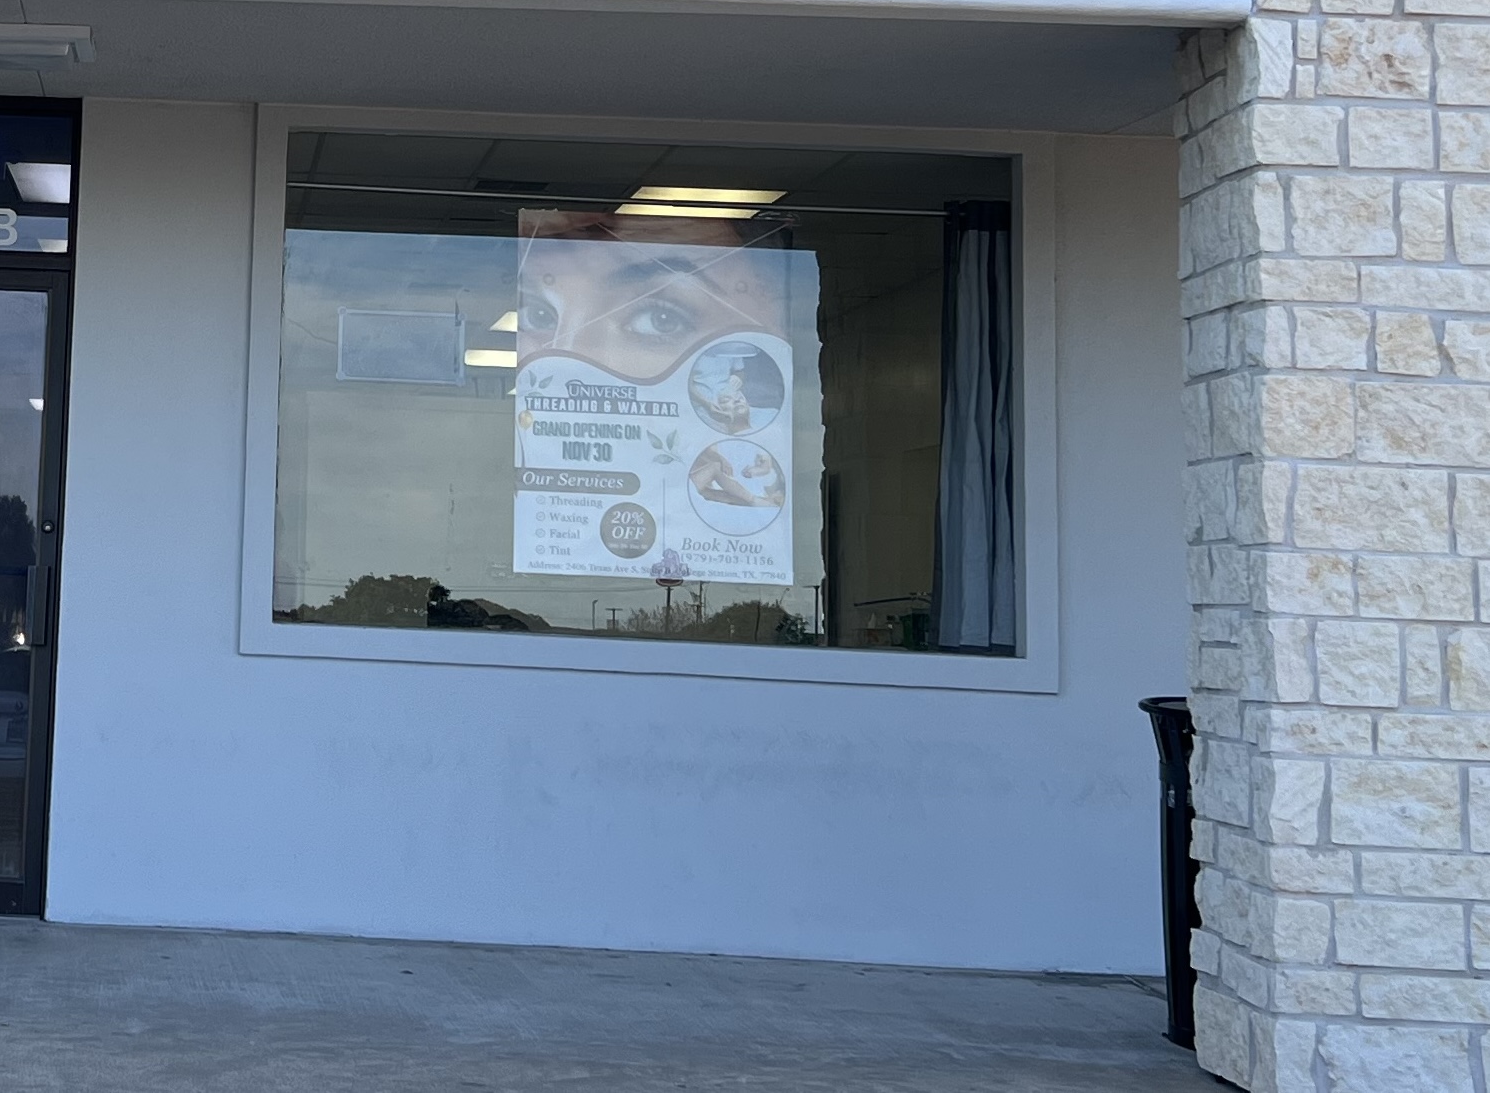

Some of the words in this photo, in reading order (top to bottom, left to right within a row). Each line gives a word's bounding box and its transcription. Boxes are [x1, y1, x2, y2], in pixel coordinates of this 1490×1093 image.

[568, 384, 636, 400] UNIVERSE
[526, 397, 598, 412] THREADING
[604, 401, 612, 413] &
[617, 401, 647, 415] WAX
[652, 403, 679, 417] BAR
[533, 420, 572, 437] GRAND
[573, 422, 624, 439] OPENING
[624, 424, 641, 440] ON
[562, 440, 592, 460] NOV
[593, 442, 613, 462] 30
[522, 471, 554, 486] Our
[557, 472, 624, 489] Services
[549, 495, 603, 508] Threading
[549, 511, 589, 524] Waxing
[611, 510, 645, 526] 20%
[549, 528, 580, 540] Facial
[611, 525, 646, 540] OFF
[549, 545, 572, 556] Tint
[681, 537, 721, 553] Book
[724, 539, 763, 555] Now
